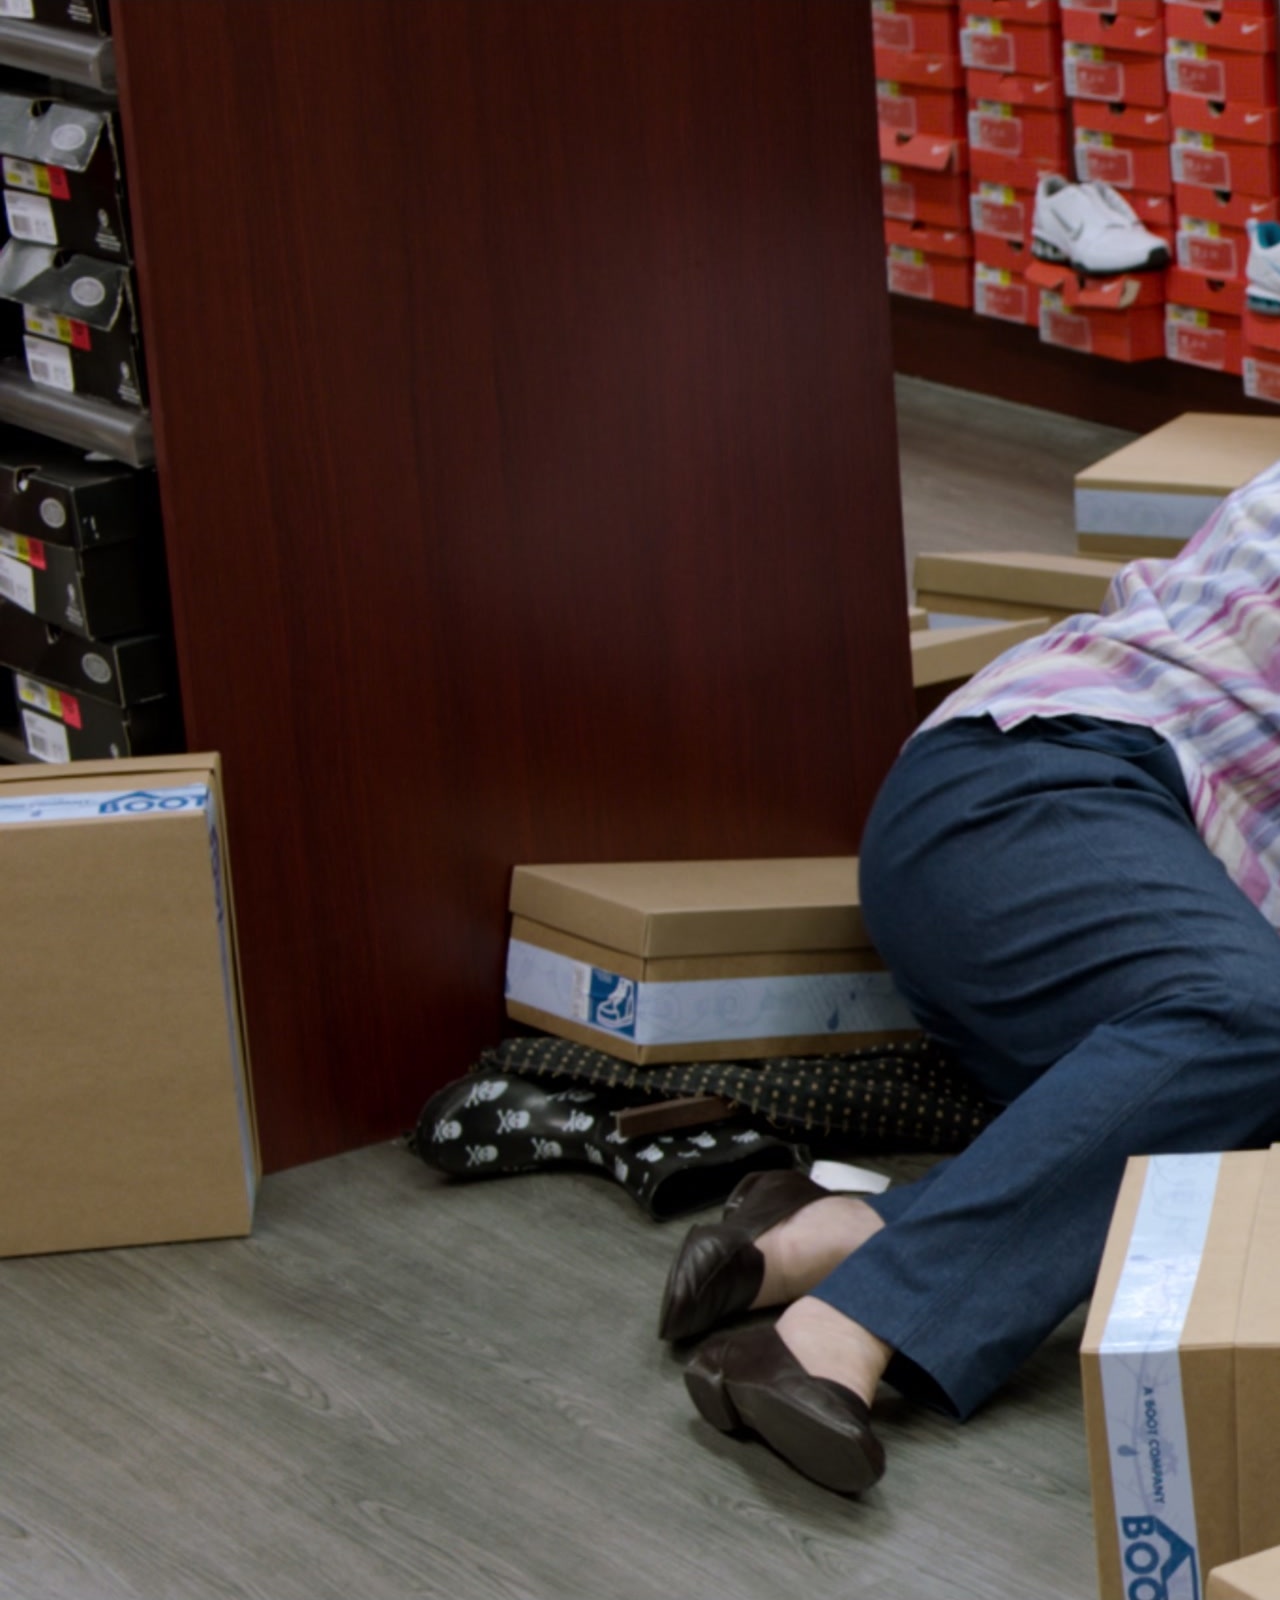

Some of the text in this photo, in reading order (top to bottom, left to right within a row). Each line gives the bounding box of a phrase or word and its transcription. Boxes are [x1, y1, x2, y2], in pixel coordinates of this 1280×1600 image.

[1144, 1401, 1159, 1435] BOOT
[1148, 1439, 1166, 1505] COMPANY
[1121, 1515, 1164, 1600] BOO
